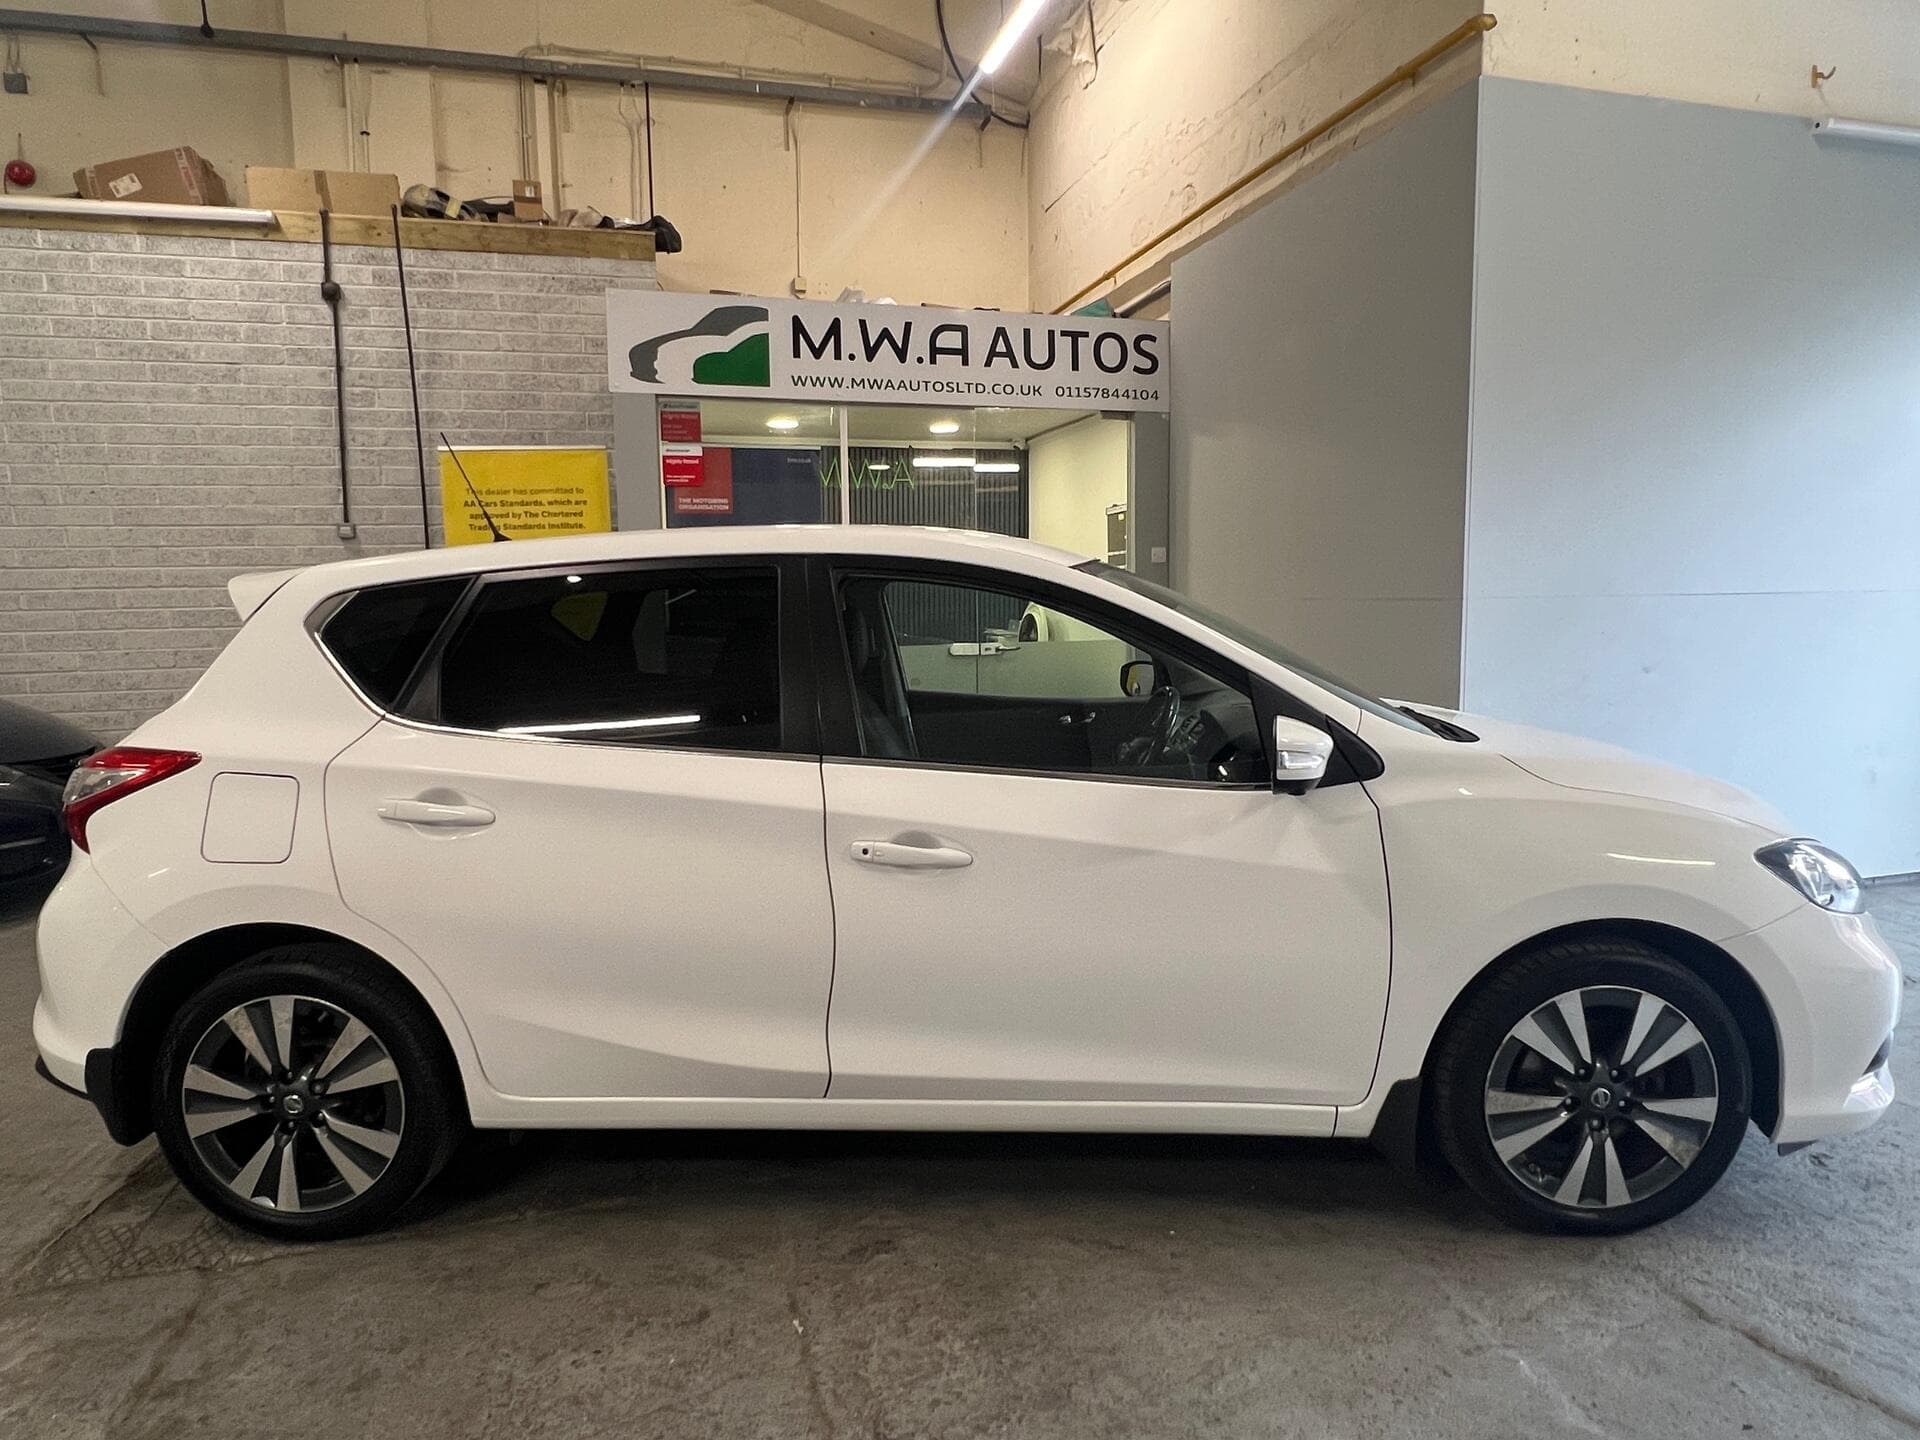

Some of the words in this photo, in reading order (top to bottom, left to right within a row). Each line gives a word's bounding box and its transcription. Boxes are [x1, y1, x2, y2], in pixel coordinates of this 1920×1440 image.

[791, 314, 970, 367] M.W.A
[983, 326, 1160, 376] AUTOS
[791, 375, 1043, 397] WWW.MWAAUTOSLTD.CO.UK
[1055, 385, 1160, 401] 01157844104
[466, 488, 484, 496] Tis
[485, 488, 511, 496] dealer
[530, 487, 574, 495] committed
[574, 487, 585, 495] to
[469, 512, 510, 520] appoved
[511, 511, 522, 520] by
[523, 511, 540, 519] The
[541, 510, 584, 518] Chartered
[503, 523, 546, 531] Standards
